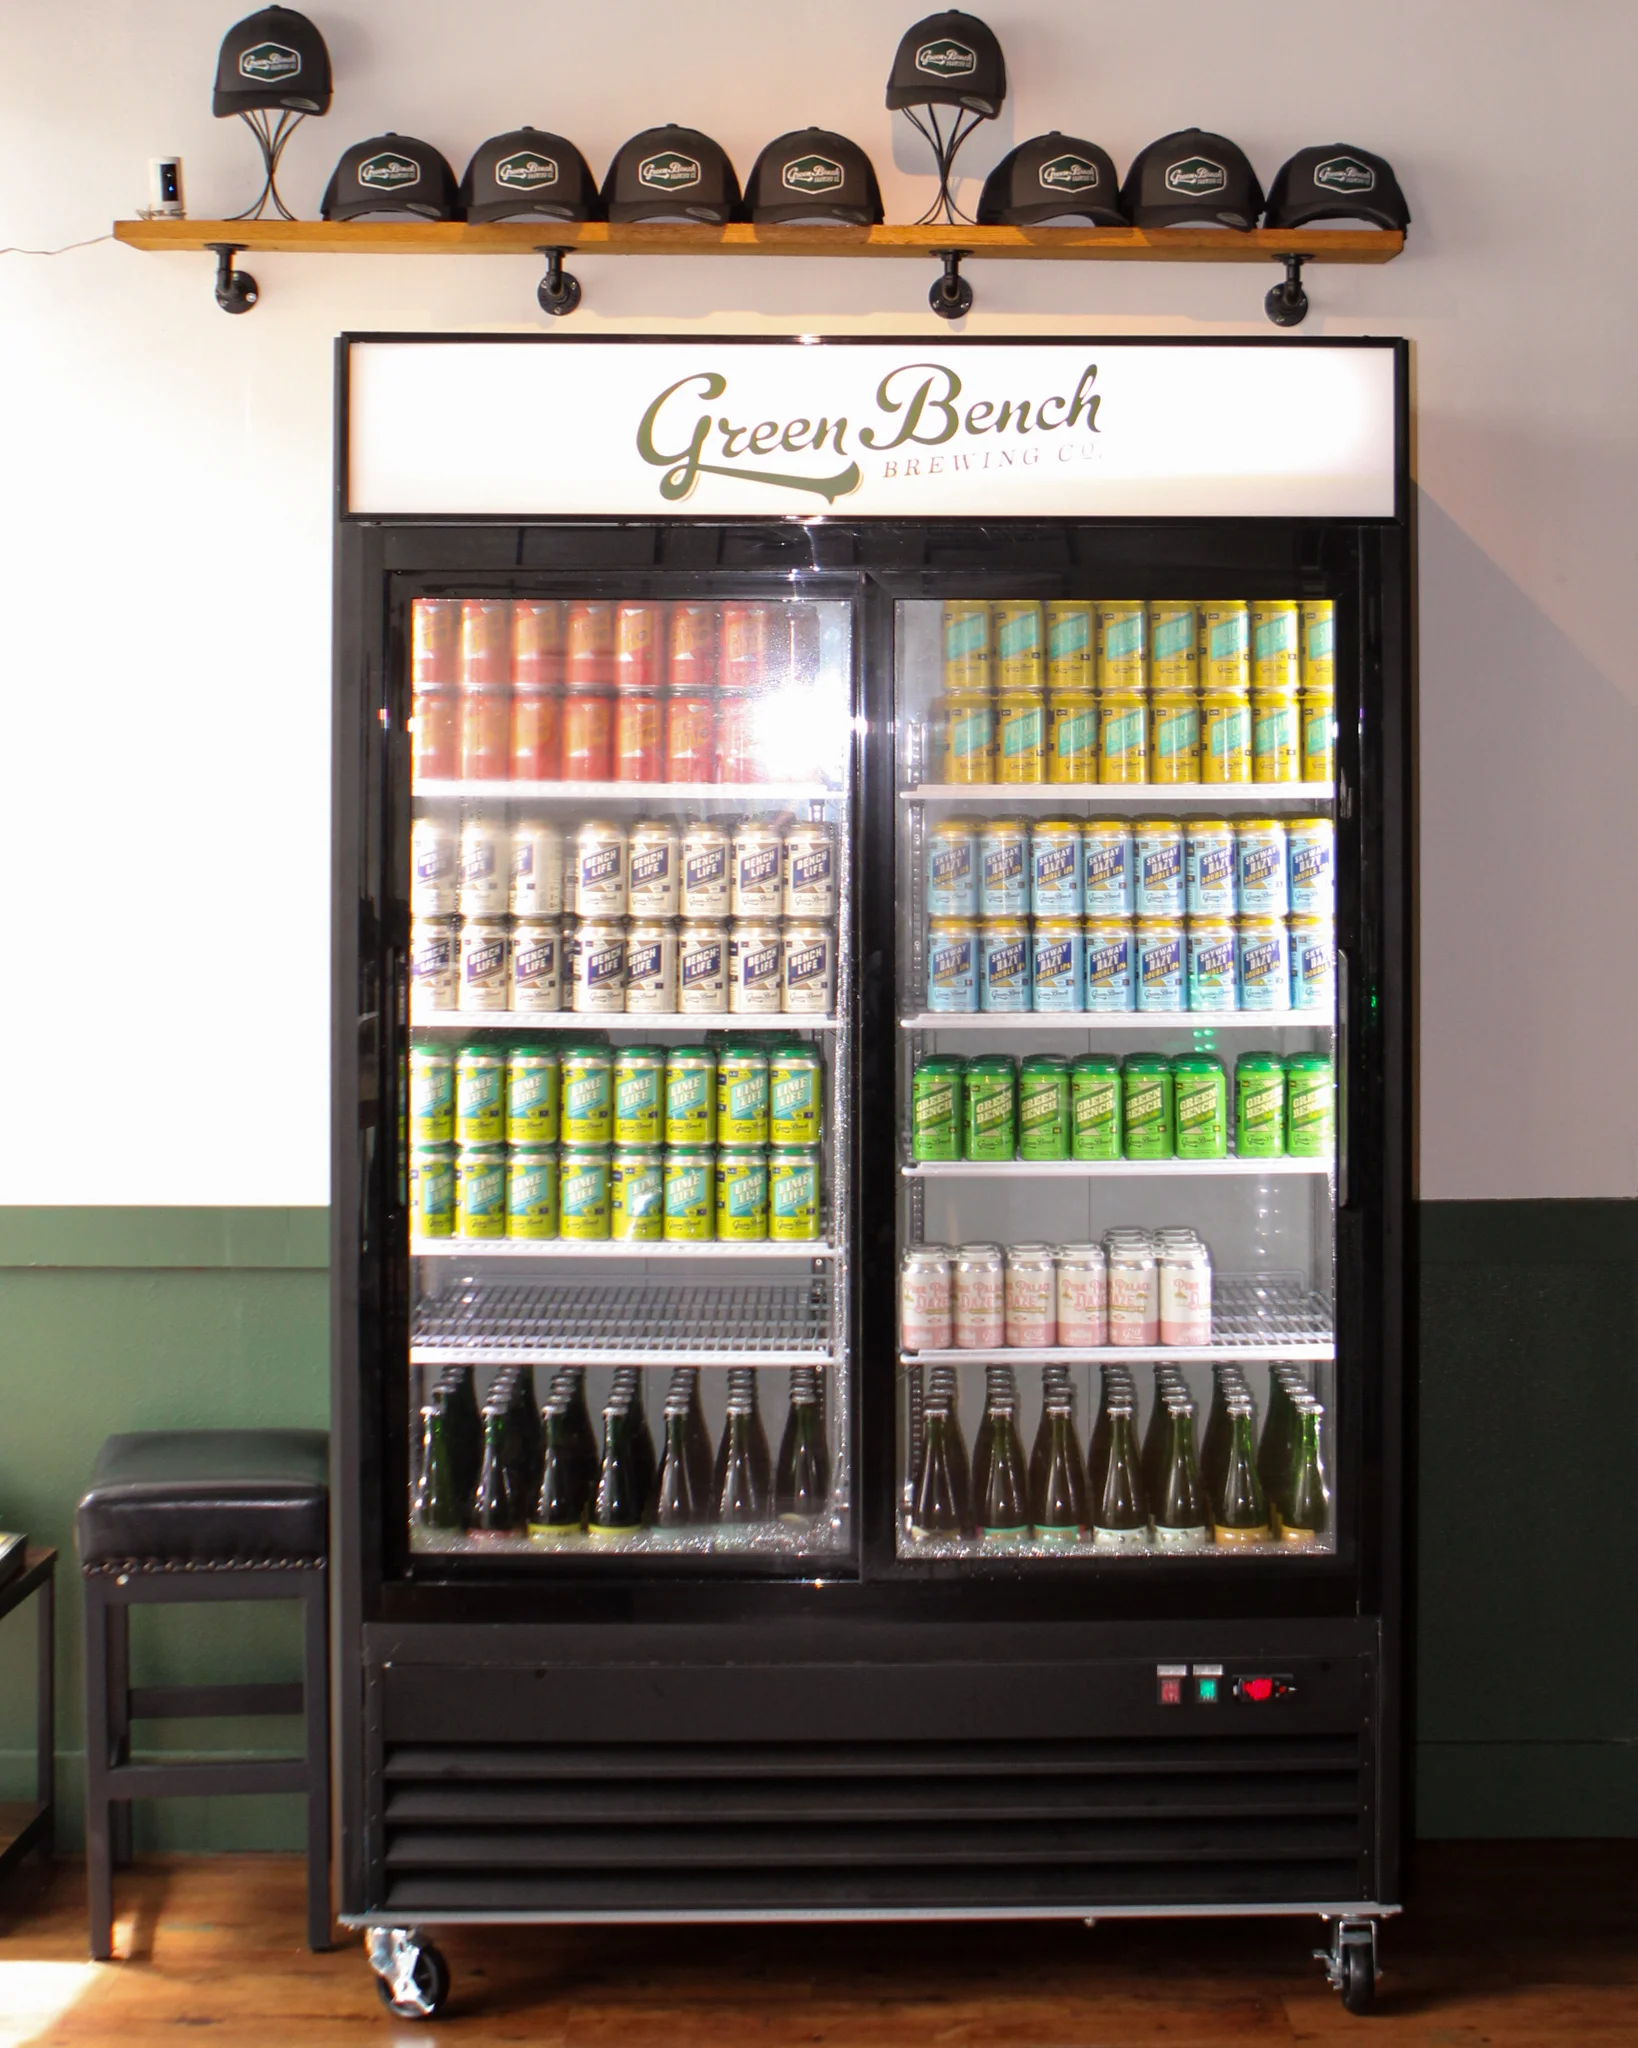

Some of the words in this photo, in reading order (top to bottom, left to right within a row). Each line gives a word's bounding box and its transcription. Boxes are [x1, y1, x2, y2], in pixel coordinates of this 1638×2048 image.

[636, 373, 861, 505] Green
[858, 363, 1102, 451] Bench
[882, 447, 1040, 479] BREWING
[585, 849, 616, 869] BENCH
[633, 850, 663, 870] BENCH
[689, 850, 721, 871] BENCH
[744, 849, 774, 870] BENCH
[796, 850, 827, 869] BENCH
[1040, 848, 1070, 865] SKYWAY
[1089, 849, 1119, 865] SKYWAY
[1147, 849, 1177, 866] SKYWAY
[1245, 849, 1277, 865] SKYWAY
[592, 861, 613, 877] LIFE
[639, 863, 659, 878] LIFE
[697, 864, 717, 879] LIFE
[751, 863, 771, 877] LIFE
[804, 863, 824, 878] LIFE
[1044, 857, 1066, 874] HAZY
[1093, 858, 1115, 874] HAZY
[1038, 870, 1061, 884] DOUBLE
[1087, 870, 1110, 884] DOUBLE
[469, 944, 501, 965] BENCH
[517, 944, 550, 965] BENCH
[592, 945, 621, 966] BENCH
[684, 947, 716, 967] BENCH
[748, 946, 777, 967] BENCH
[791, 946, 822, 966] BENCH
[935, 945, 966, 962] SKYWAY
[991, 945, 1022, 962] SKYWAY
[1037, 944, 1068, 962] SKYWAY
[1092, 945, 1123, 962] SKYWAY
[1145, 944, 1176, 961] SKYWAY
[1245, 944, 1277, 961] SKYWAY
[476, 958, 497, 973] LIFE
[525, 957, 546, 973] LIFE
[599, 959, 618, 974] LIFE
[633, 961, 650, 974] LIFE
[691, 961, 712, 975] LIFE
[755, 961, 774, 974] LIFE
[797, 960, 818, 974] LIFE
[1040, 954, 1063, 971] HAZY
[1097, 954, 1118, 971] HAZY
[1150, 954, 1171, 971] HAZY
[1036, 966, 1059, 980] DOUBLE
[1091, 966, 1115, 981] DOUBLE
[1144, 967, 1168, 980] DOUBLE
[620, 1077, 651, 1096] LIME
[670, 1077, 700, 1096] LIME
[736, 1078, 763, 1098] LIME
[776, 1077, 806, 1096] LIME
[624, 1092, 647, 1106] LIFE
[672, 1091, 695, 1105] LIFE
[740, 1092, 762, 1107] LIFE
[780, 1092, 802, 1106] LIFE
[917, 1090, 951, 1111] GREEN
[976, 1090, 1011, 1112] GREEN
[1022, 1090, 1056, 1111] GREEN
[1077, 1090, 1113, 1112] GREEN
[1126, 1088, 1161, 1109] GREEN
[1180, 1088, 1216, 1110] GREEN
[917, 1101, 952, 1122] BENCH
[977, 1101, 1012, 1122] BENCH
[1022, 1101, 1057, 1121] BENCH
[1077, 1101, 1113, 1121] BENCH
[1126, 1099, 1161, 1120] BENCH
[1180, 1099, 1216, 1121] BENCH
[567, 1174, 596, 1193] LIME
[670, 1175, 699, 1193] LIME
[734, 1175, 763, 1195] LIME
[777, 1174, 809, 1194] LIME
[672, 1189, 695, 1203] LIFE
[782, 1190, 805, 1204] LIFE
